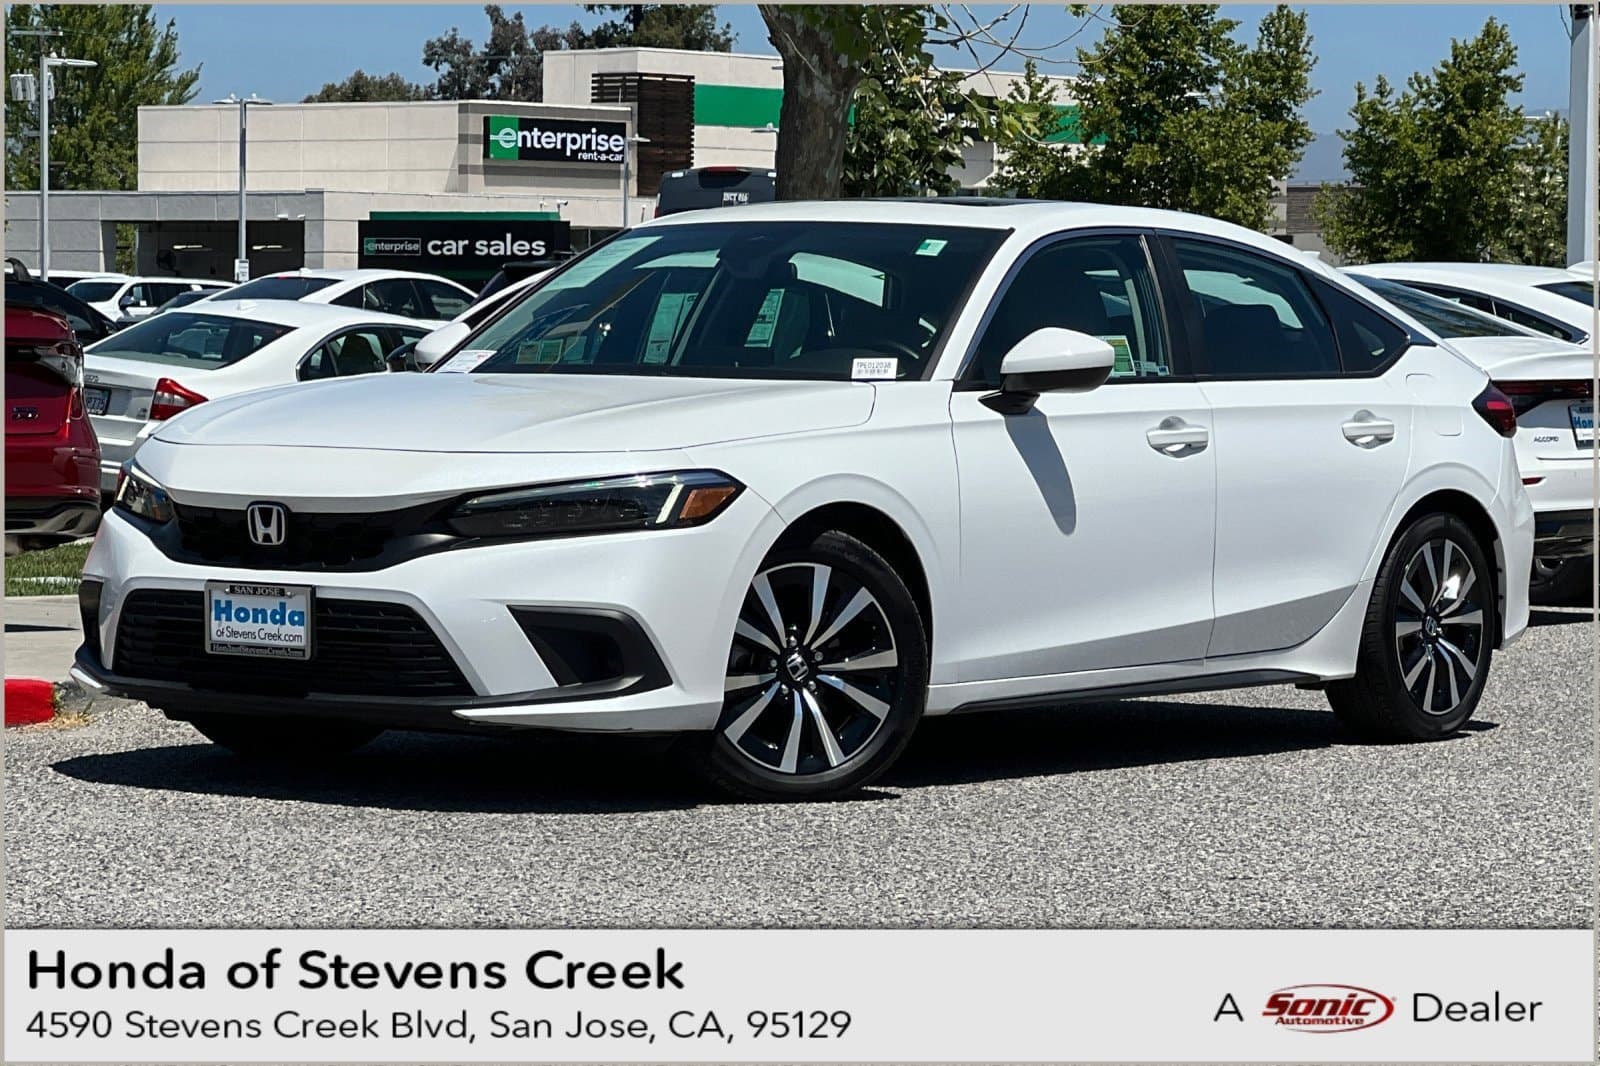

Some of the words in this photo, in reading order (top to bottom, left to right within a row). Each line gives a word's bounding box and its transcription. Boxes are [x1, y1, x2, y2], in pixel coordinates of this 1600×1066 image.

[490, 128, 625, 156] enterprise
[578, 152, 624, 161] rent-a-car
[366, 240, 419, 253] enterprise
[427, 239, 468, 256] car
[475, 233, 546, 256] sales
[234, 586, 254, 594] SAN
[256, 587, 281, 595] JOSE
[214, 599, 305, 626] Honda
[216, 628, 225, 638] of
[225, 626, 257, 640] Stevens
[258, 628, 303, 643] Creek.com
